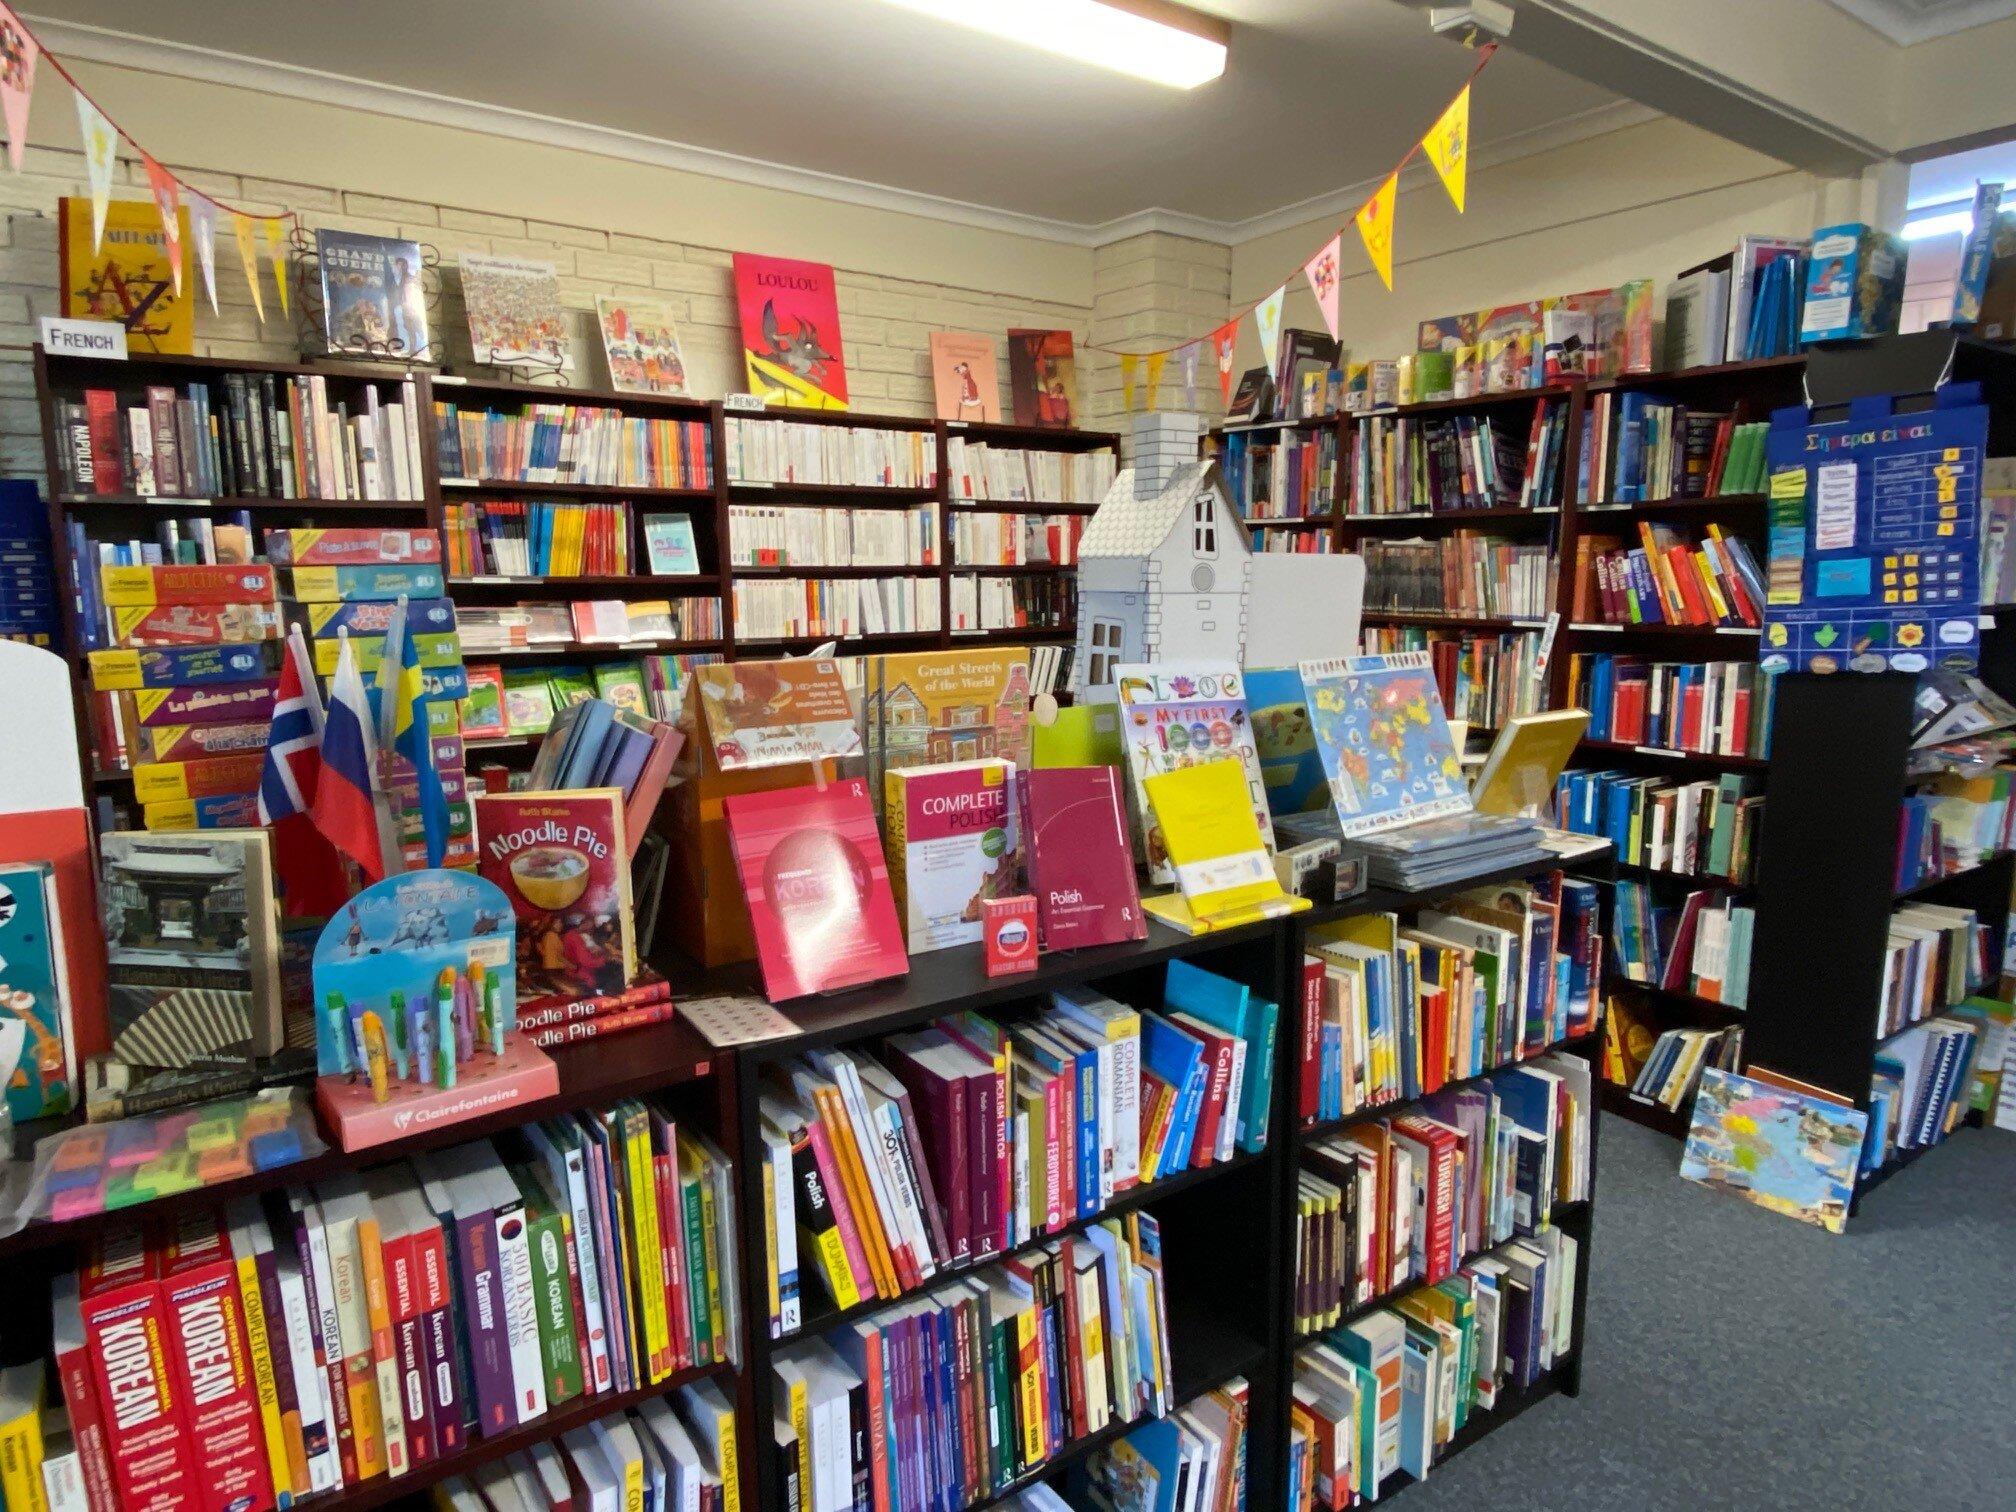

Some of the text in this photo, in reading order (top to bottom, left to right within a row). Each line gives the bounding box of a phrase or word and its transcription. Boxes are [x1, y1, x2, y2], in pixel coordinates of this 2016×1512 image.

[757, 272, 819, 292] LOULOU
[50, 327, 114, 351] FRENCH
[72, 424, 95, 484] NAPOLEON
[1596, 556, 1607, 590] Collins
[917, 660, 1003, 678] Great Streets
[925, 675, 996, 691] of the World
[1155, 721, 1233, 751] 1000
[1156, 707, 1228, 723] MY FIRST
[923, 790, 1004, 815] COMPLETE
[950, 807, 1004, 829] POLISH
[488, 820, 608, 862] Noodle Pie
[1050, 889, 1083, 906] Polish
[515, 1001, 596, 1032] oodle Pie
[528, 1023, 597, 1049] odle Pie
[1113, 1044, 1124, 1114] ROMANIAN
[1122, 1040, 1134, 1110] COMPLETE
[1212, 1046, 1231, 1101] Collins
[415, 1087, 519, 1124] Clairefontaine
[996, 1078, 1006, 1159] POLISH TUTOR
[804, 1170, 825, 1210] Polish
[1435, 1150, 1454, 1214] TURKISH
[336, 1253, 351, 1305] Korean
[395, 1257, 411, 1318] ESSENTIAL
[424, 1248, 442, 1307] ESSENTIAL
[826, 1236, 851, 1292] DUMMIES
[475, 1271, 494, 1331] Grammar
[511, 1242, 539, 1345] 500 BASIC
[547, 1279, 565, 1331] KOREAN
[178, 1295, 237, 1406] KOREAN
[223, 1296, 247, 1389] CONVERSATIONAL
[246, 1290, 275, 1406] COMPLETE KOREAN
[322, 1308, 342, 1361] KOREAN
[401, 1320, 416, 1371] Korean
[431, 1311, 445, 1359] Korean
[99, 1317, 162, 1431] KOREAN
